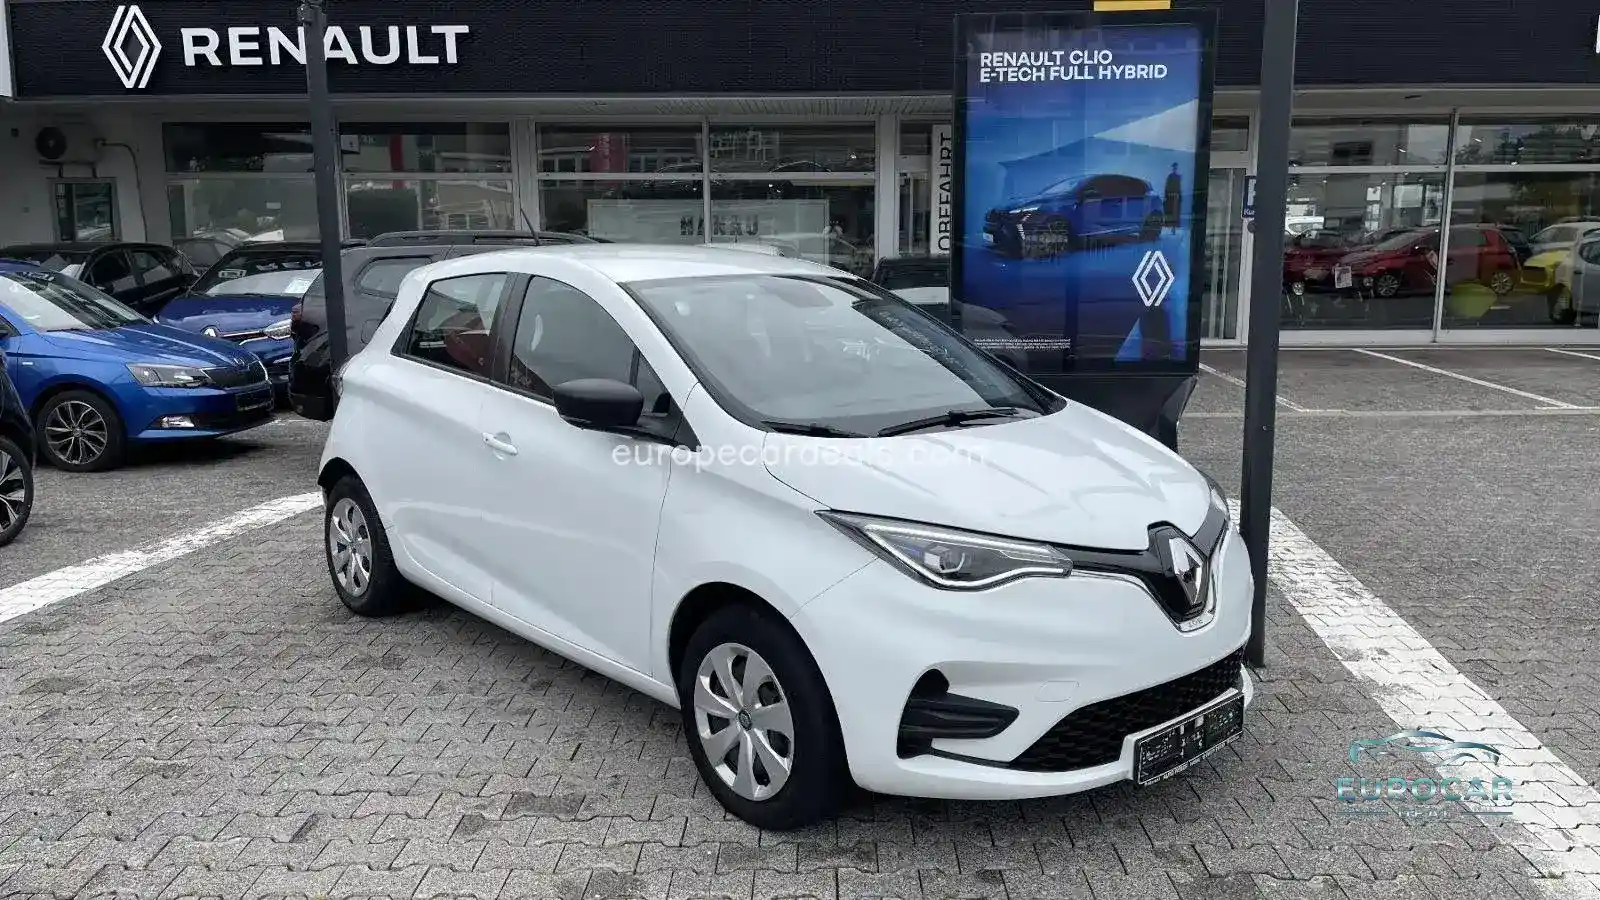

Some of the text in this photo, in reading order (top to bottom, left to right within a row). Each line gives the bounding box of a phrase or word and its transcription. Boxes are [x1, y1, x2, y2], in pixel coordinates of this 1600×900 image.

[180, 25, 470, 67] RENAULT
[980, 49, 1113, 67] RENAULT CLIO
[979, 64, 1168, 83] E-TECH FULL HYBRID
